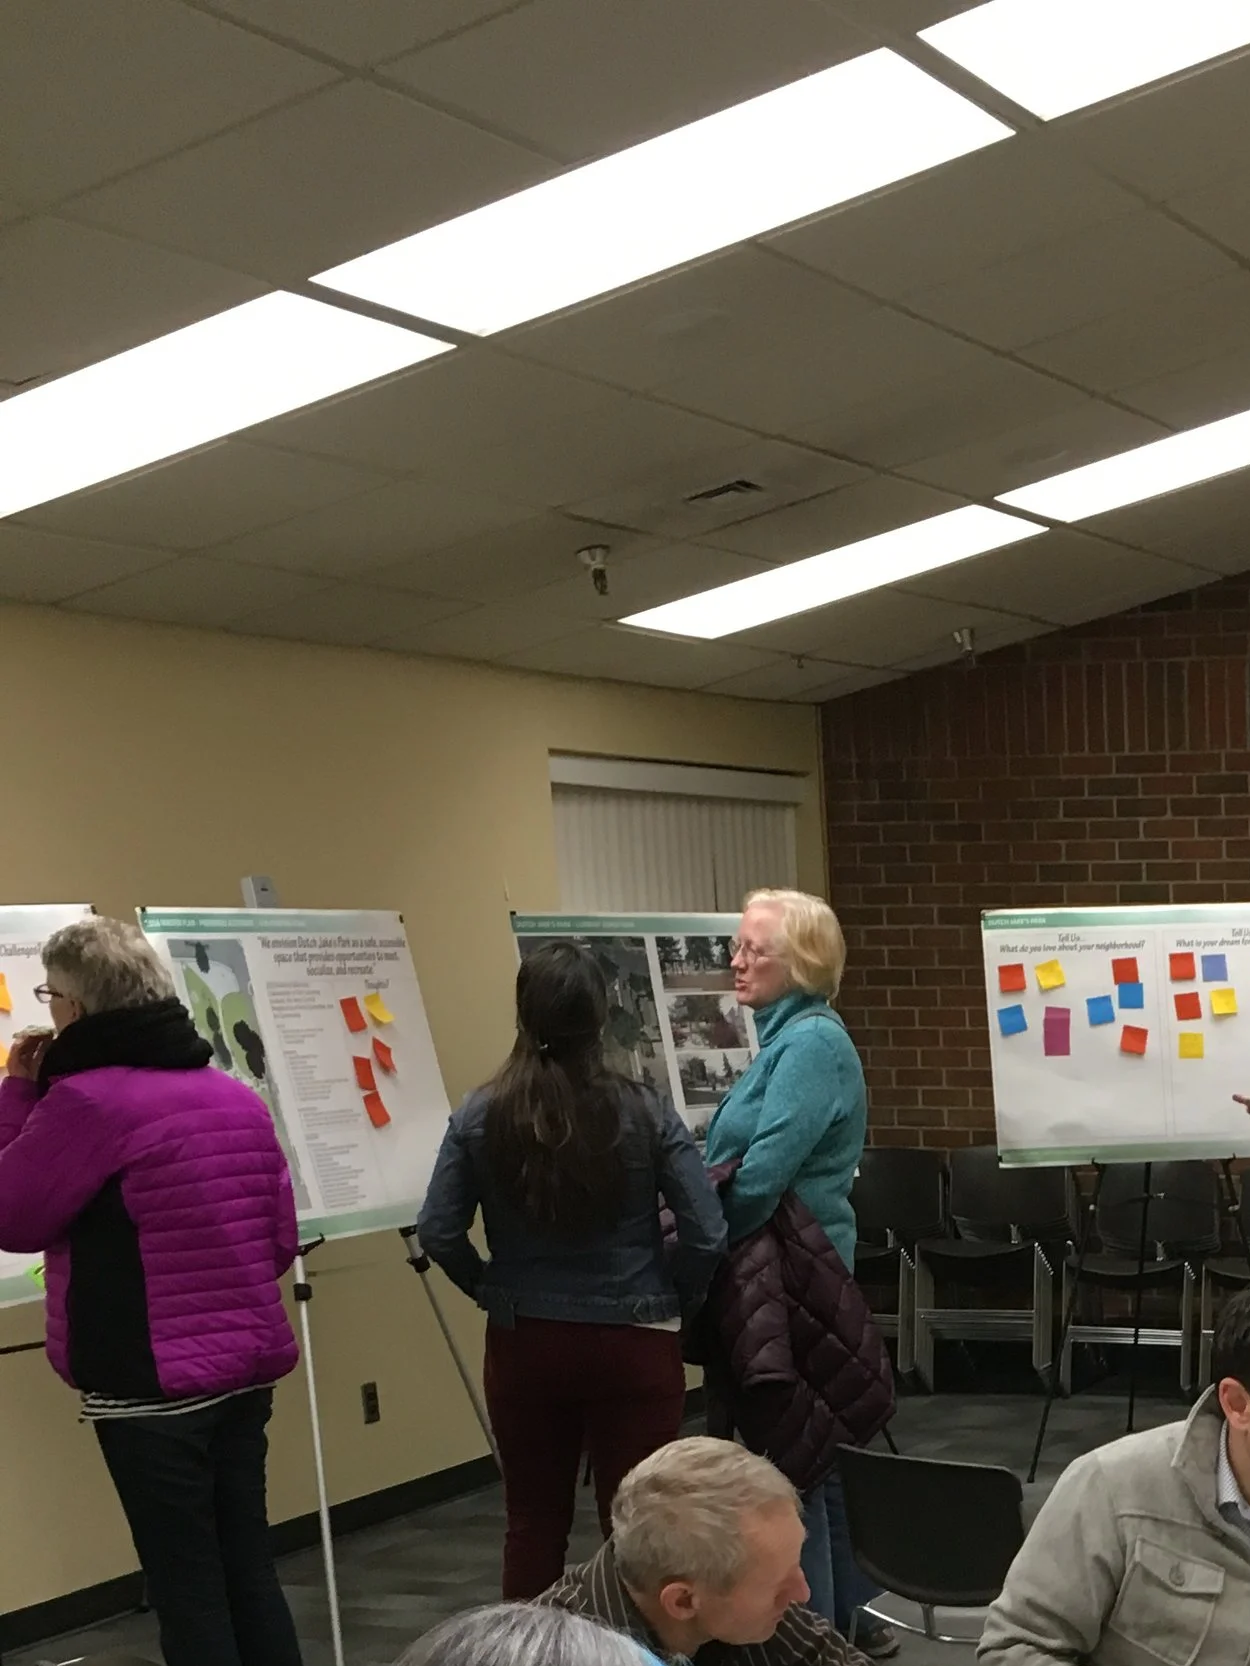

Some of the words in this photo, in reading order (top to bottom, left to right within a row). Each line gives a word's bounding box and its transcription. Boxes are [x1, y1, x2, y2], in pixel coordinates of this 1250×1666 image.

[1057, 933, 1069, 942] Tell
[1231, 928, 1243, 937] Tell
[1000, 943, 1018, 953] What
[1019, 943, 1029, 952] do
[1029, 945, 1041, 954] you
[1043, 942, 1056, 951] love
[1058, 942, 1077, 951] about
[1078, 944, 1095, 953] your
[1095, 940, 1145, 952] neighborhood?
[1176, 939, 1194, 947] What
[1202, 939, 1219, 949] your
[1219, 937, 1240, 946] dream
[293, 951, 308, 962] that
